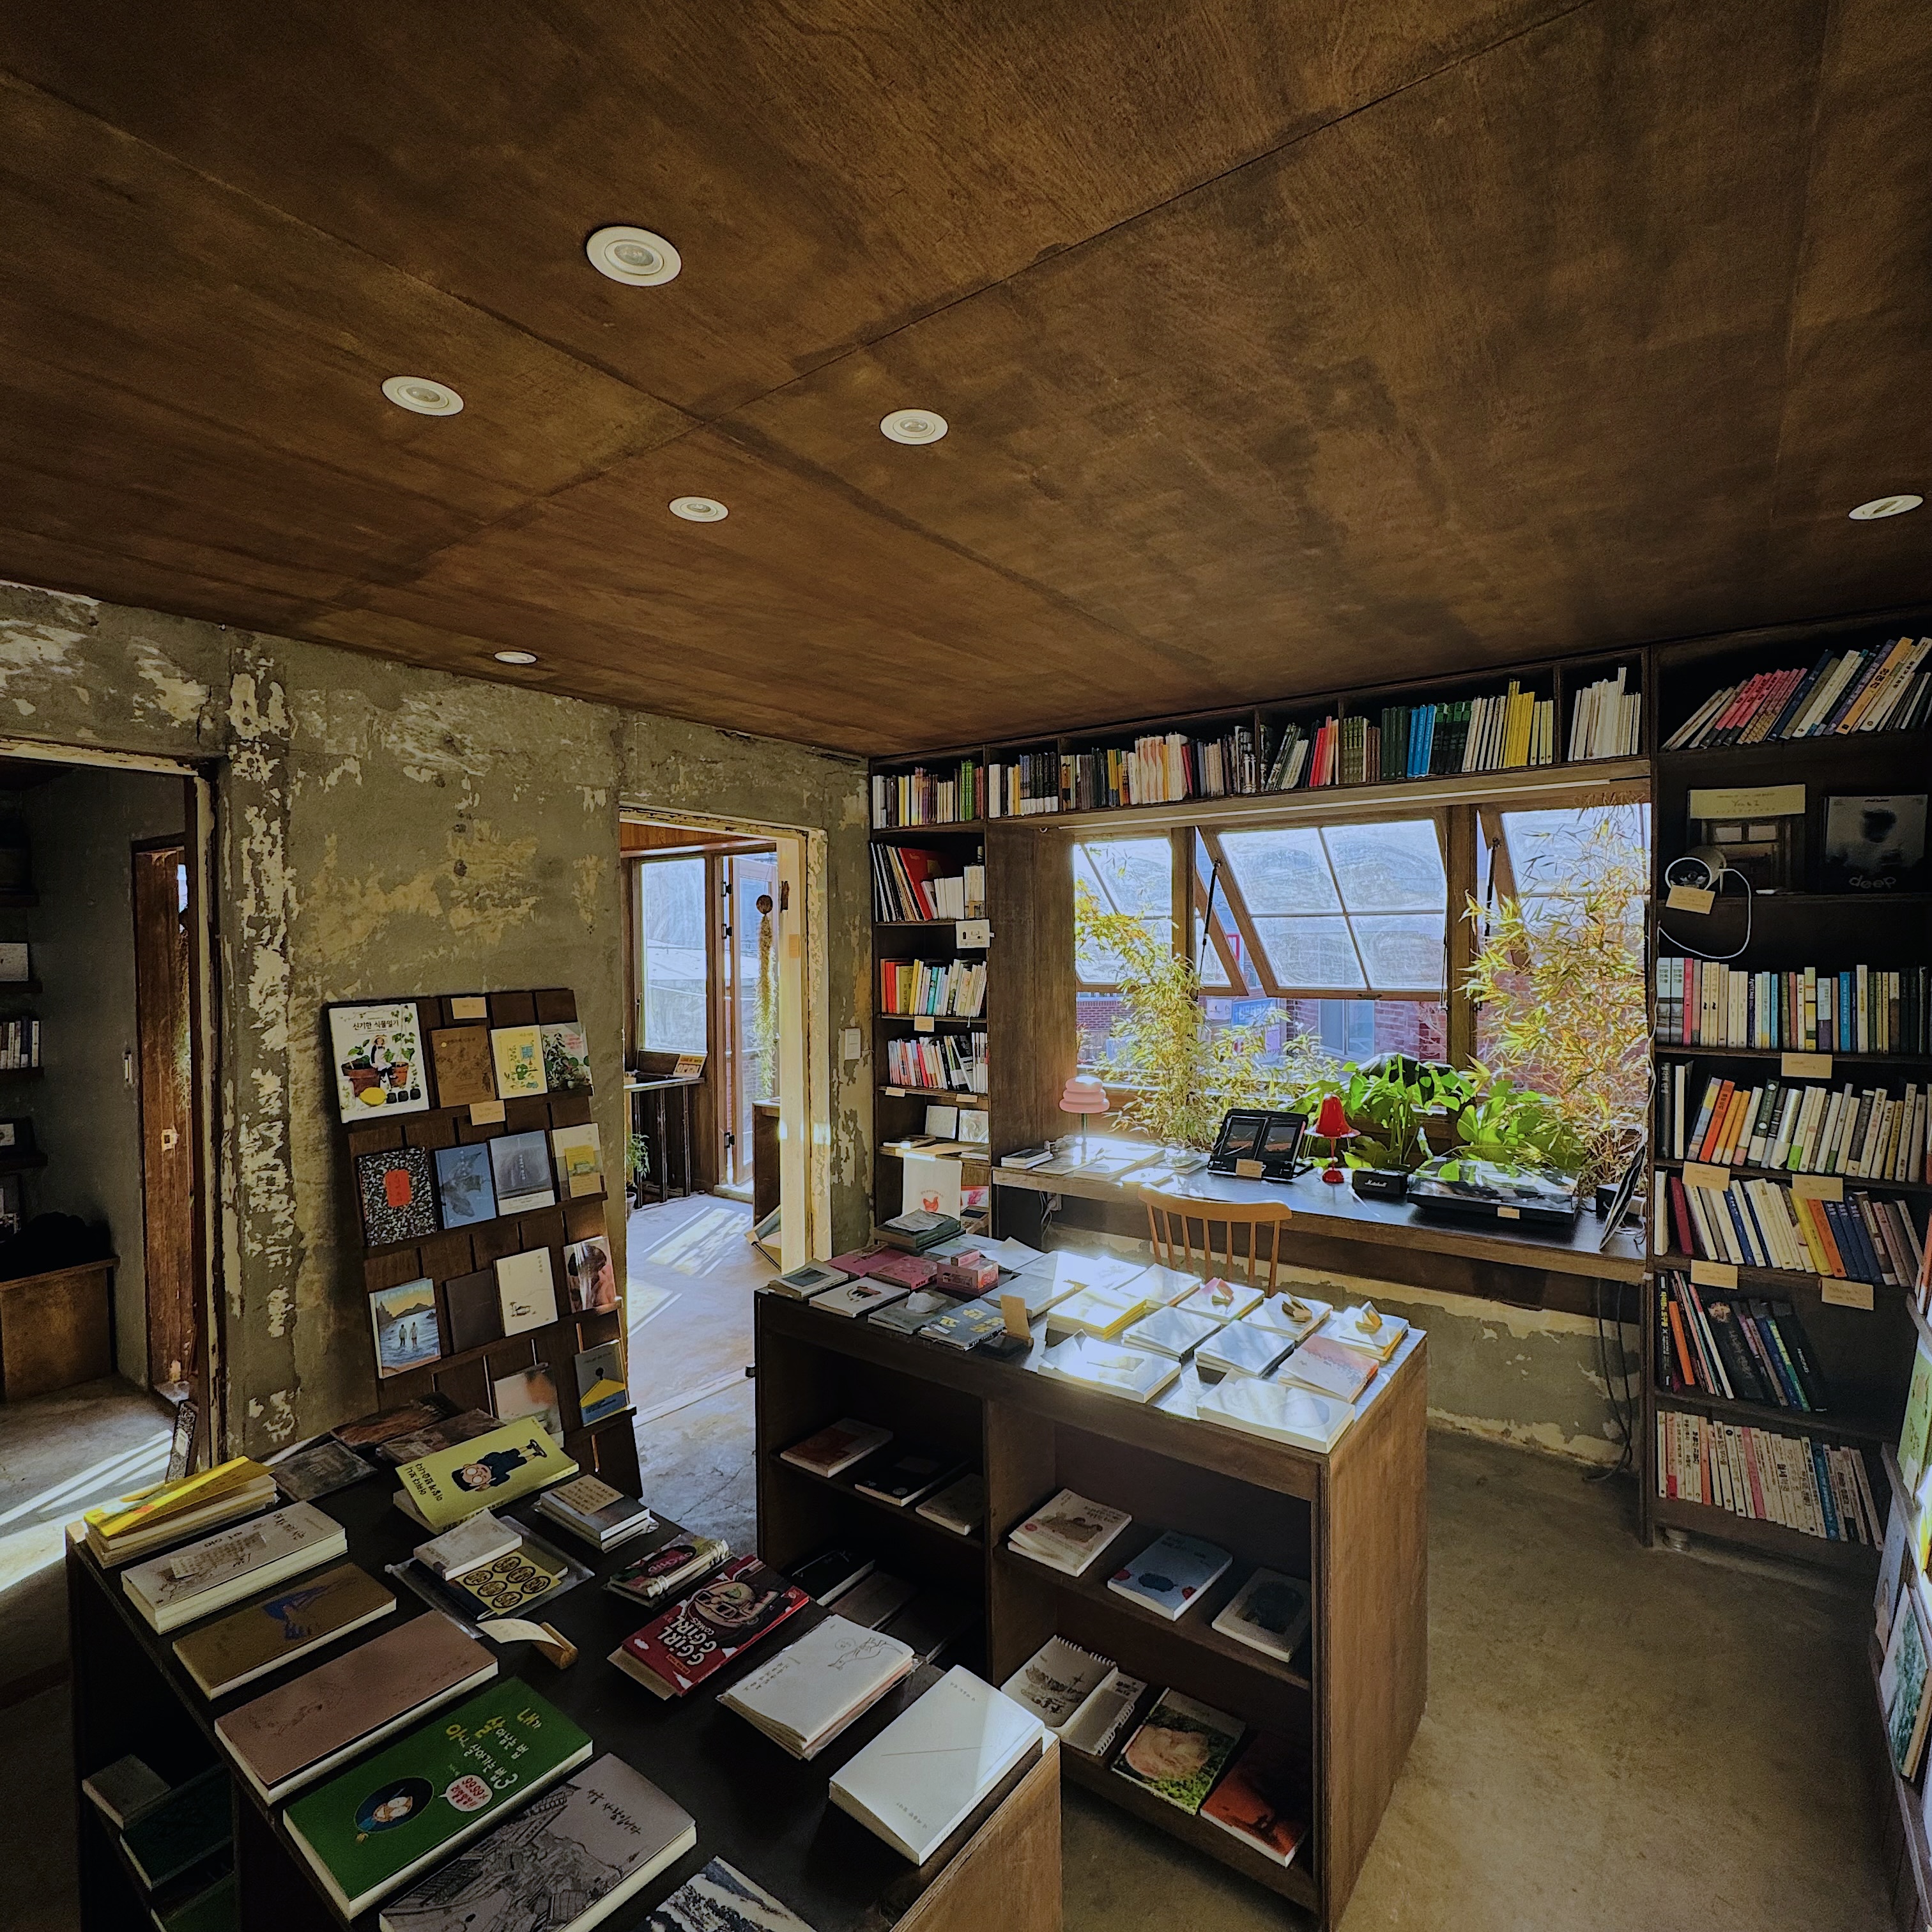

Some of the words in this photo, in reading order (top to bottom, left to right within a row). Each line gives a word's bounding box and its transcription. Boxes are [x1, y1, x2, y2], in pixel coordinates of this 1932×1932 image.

[1848, 875, 1897, 889] deep
[352, 1022, 372, 1031] 신기한
[516, 1707, 542, 1729] 내가
[474, 1715, 518, 1751] 살아남는
[510, 1743, 530, 1760] 법
[463, 1743, 496, 1774] 살아가는
